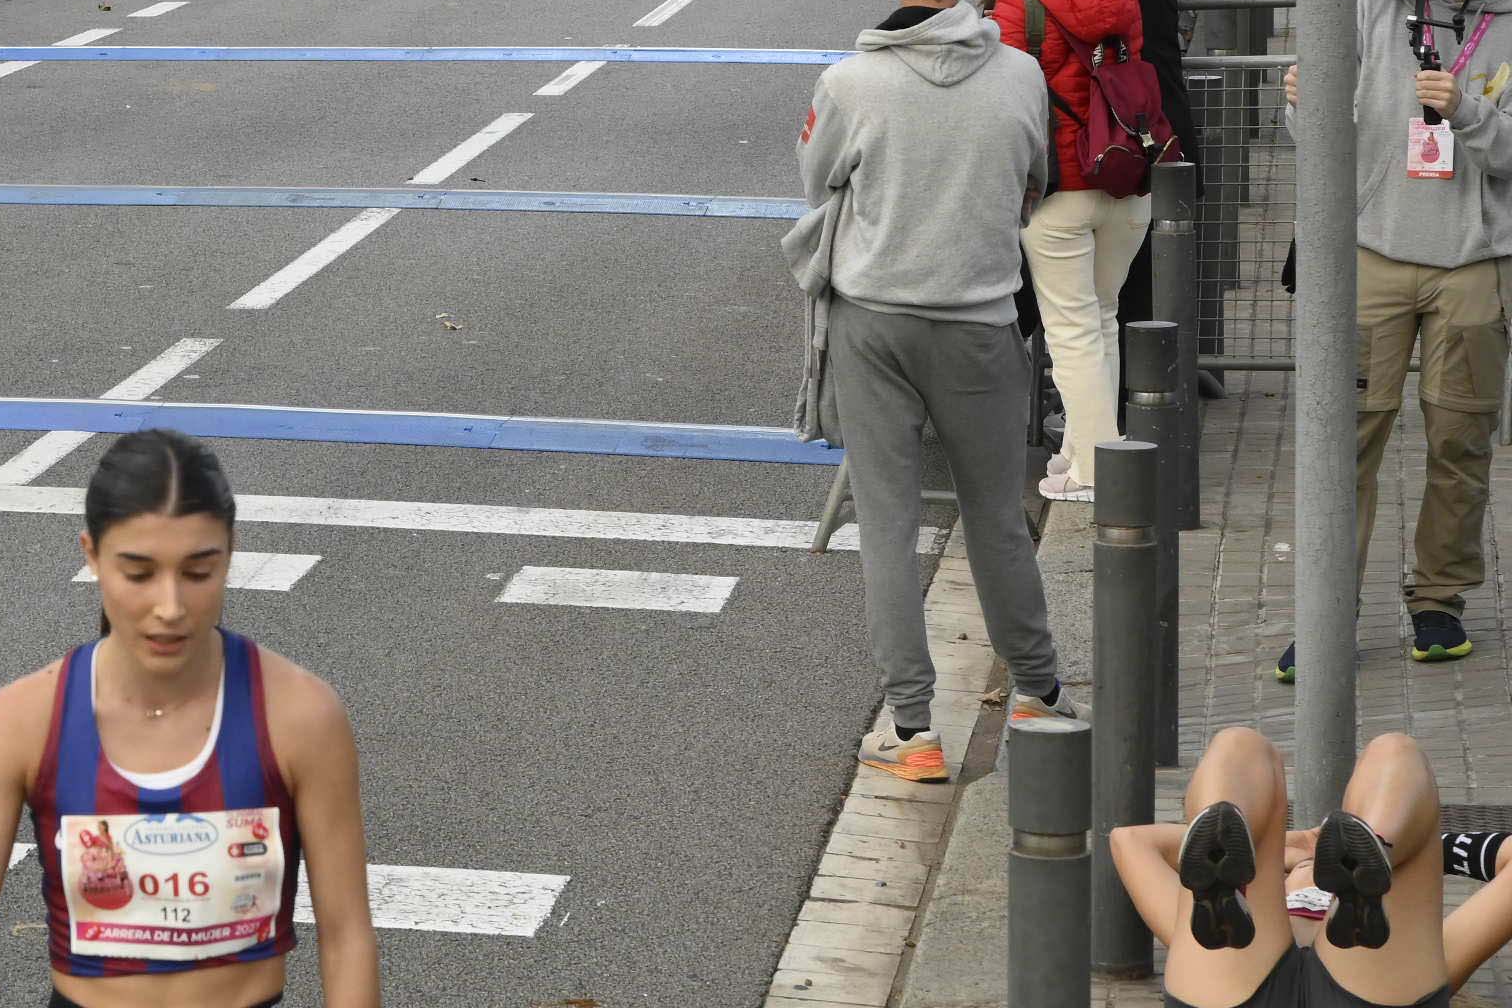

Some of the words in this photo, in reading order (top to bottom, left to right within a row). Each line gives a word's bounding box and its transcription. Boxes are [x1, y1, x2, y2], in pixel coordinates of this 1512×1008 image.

[132, 830, 211, 843] ASTURIANA
[138, 870, 211, 897] 016
[161, 906, 191, 923] 112
[154, 926, 170, 942] DE
[172, 927, 188, 942] LA
[191, 927, 230, 942] MUJER
